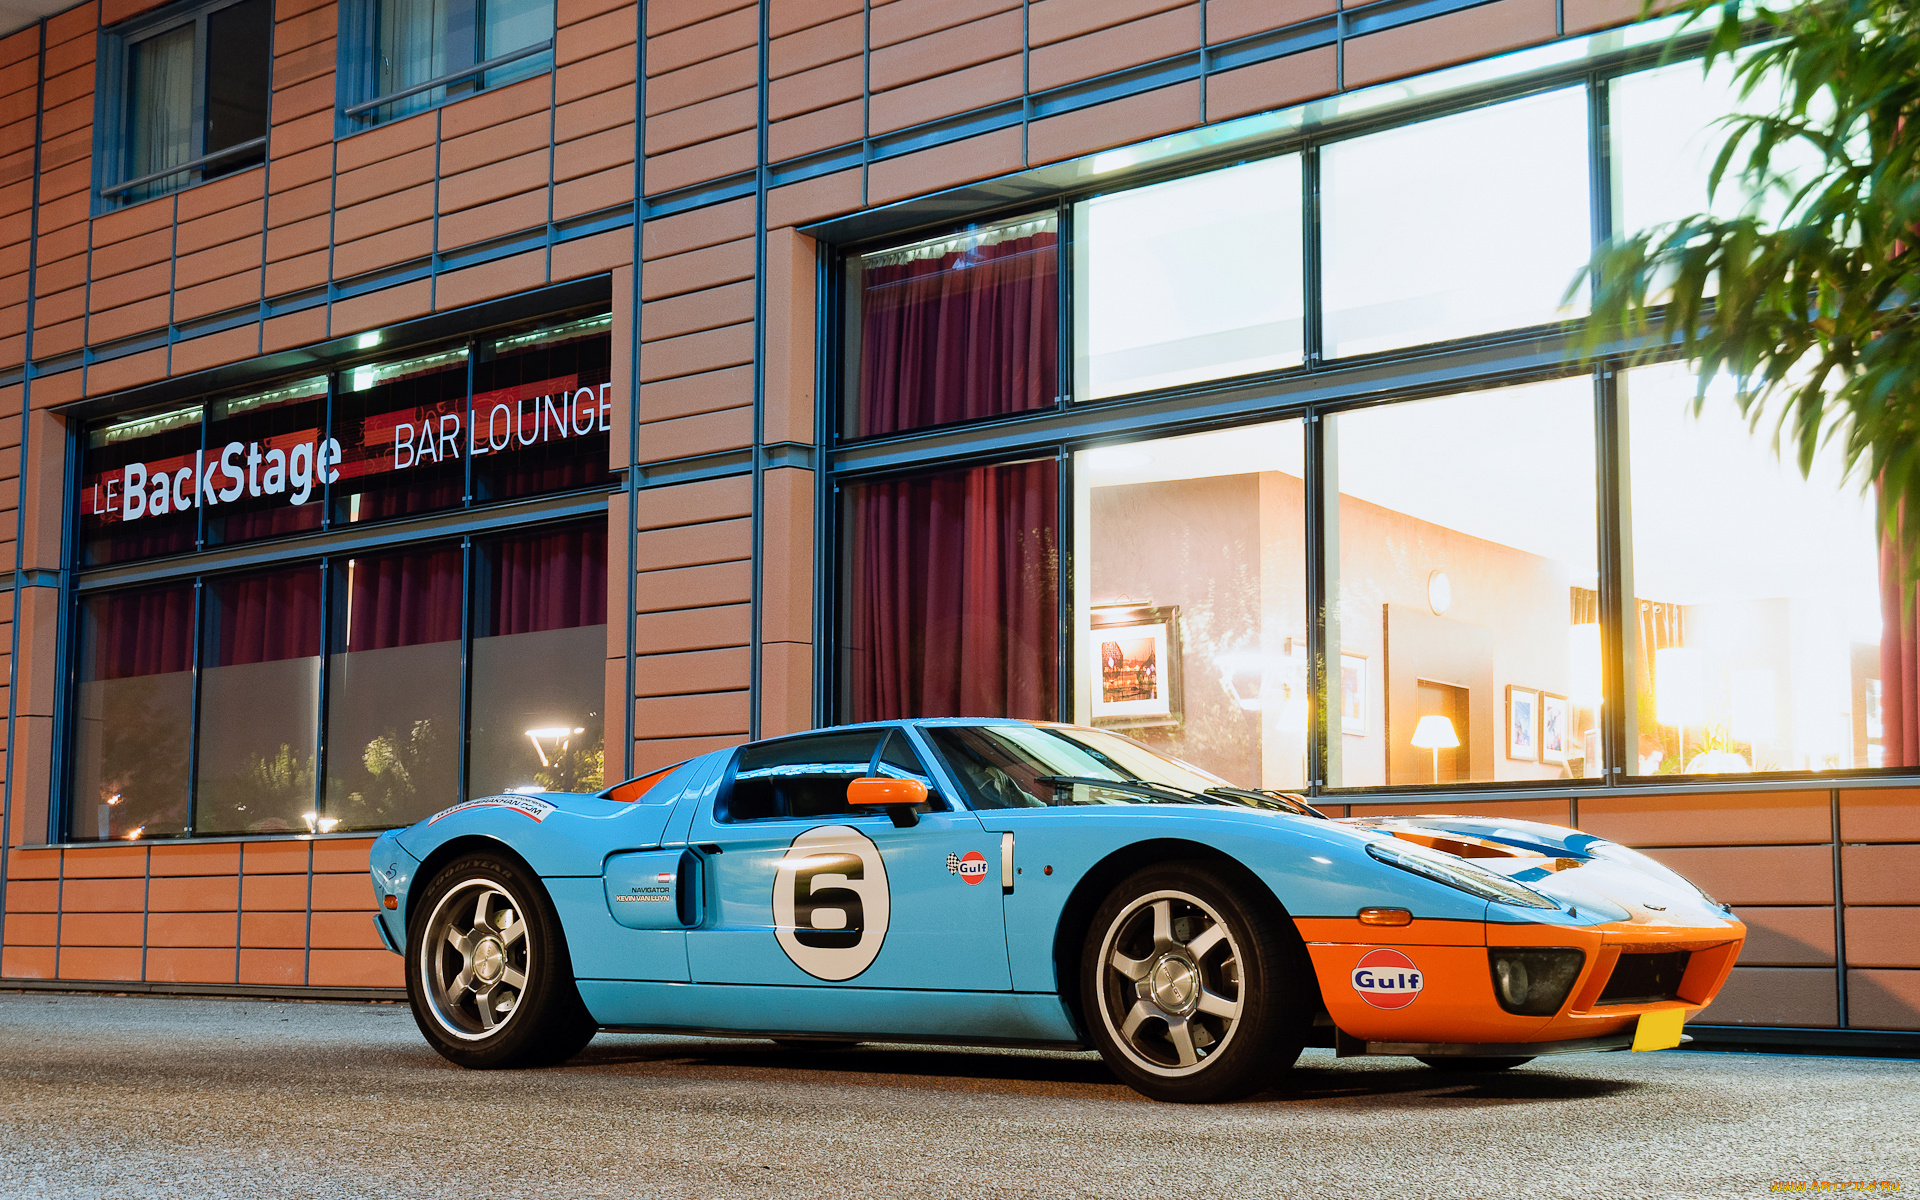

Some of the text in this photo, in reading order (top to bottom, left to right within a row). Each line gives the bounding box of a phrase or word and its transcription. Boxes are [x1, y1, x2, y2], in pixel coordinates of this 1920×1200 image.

[394, 382, 611, 469] BAR LOUNGE
[93, 437, 342, 522] LE BackStage
[960, 863, 987, 873] Gulf
[616, 894, 635, 902] KEVIN
[635, 894, 651, 902] VAN
[794, 852, 864, 949] 6
[1355, 970, 1420, 989] Gulf
